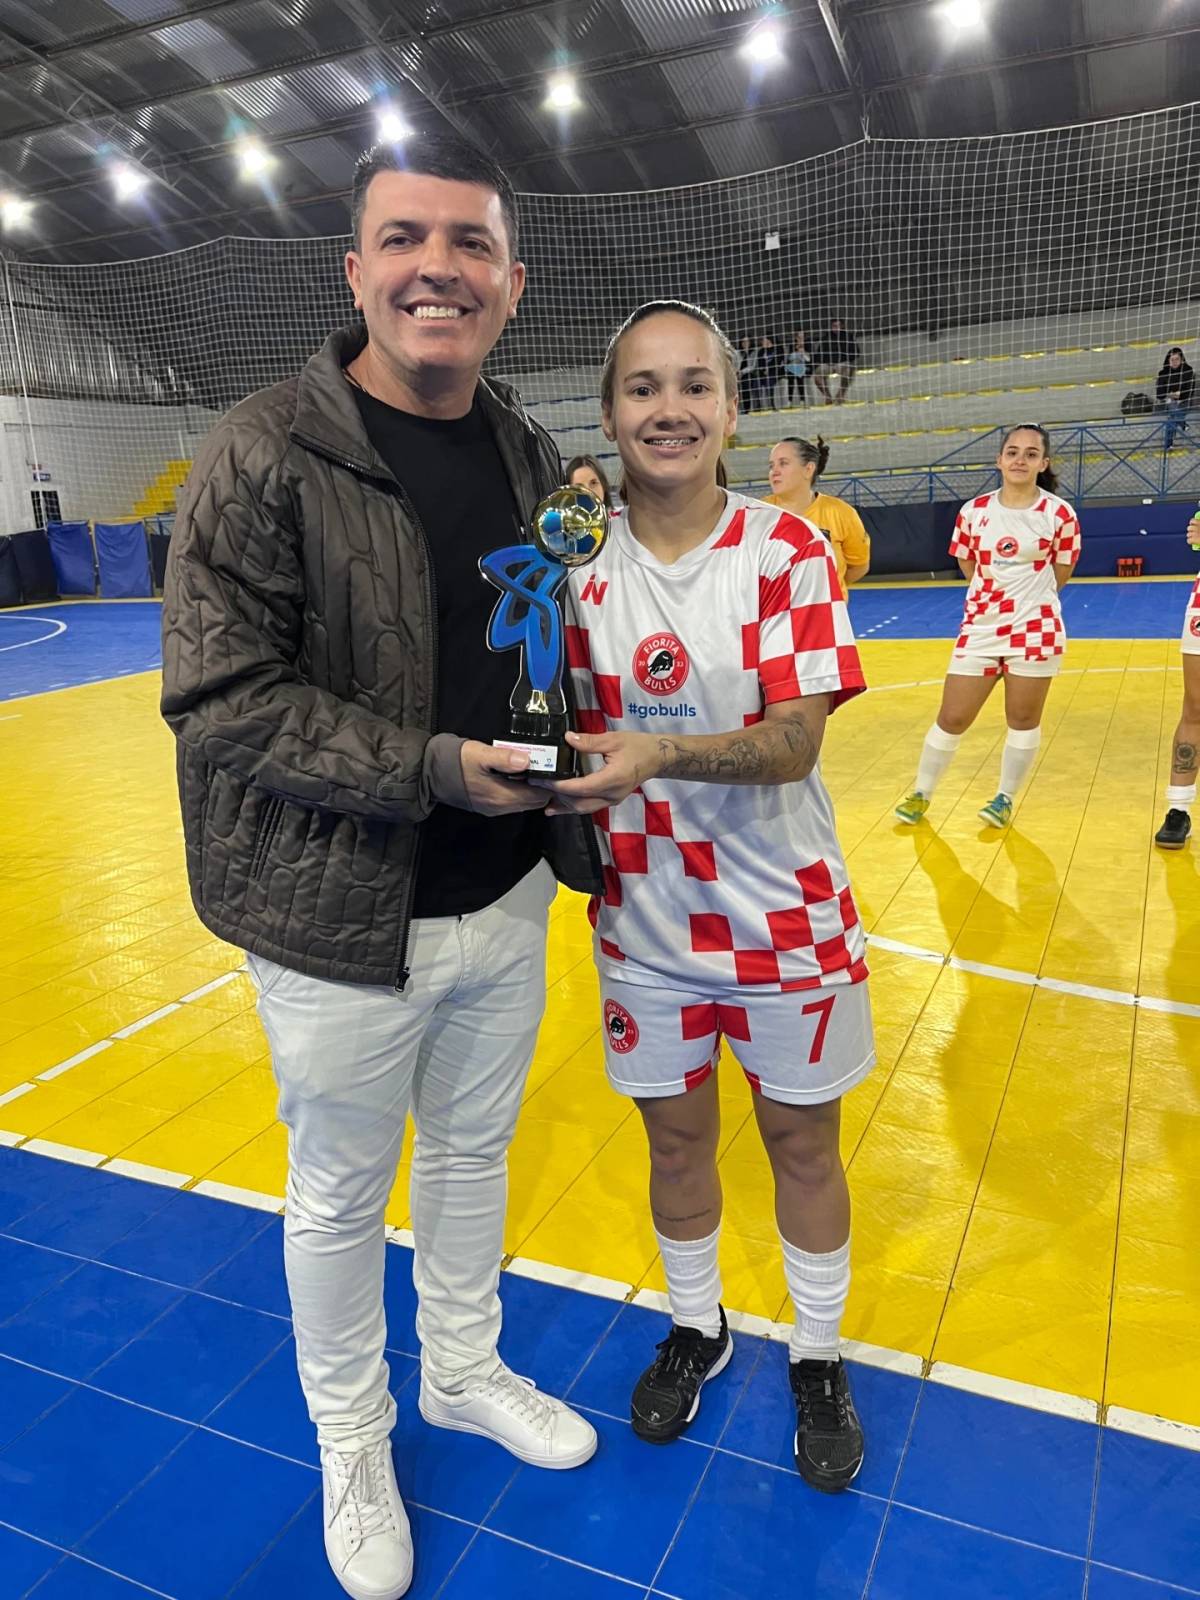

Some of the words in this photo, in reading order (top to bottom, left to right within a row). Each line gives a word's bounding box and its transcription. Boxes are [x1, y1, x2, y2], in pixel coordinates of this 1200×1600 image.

[643, 637, 680, 657] FIORITA
[643, 677, 677, 691] BULLS
[627, 703, 696, 719] #gobulls
[801, 994, 836, 1064] 7
